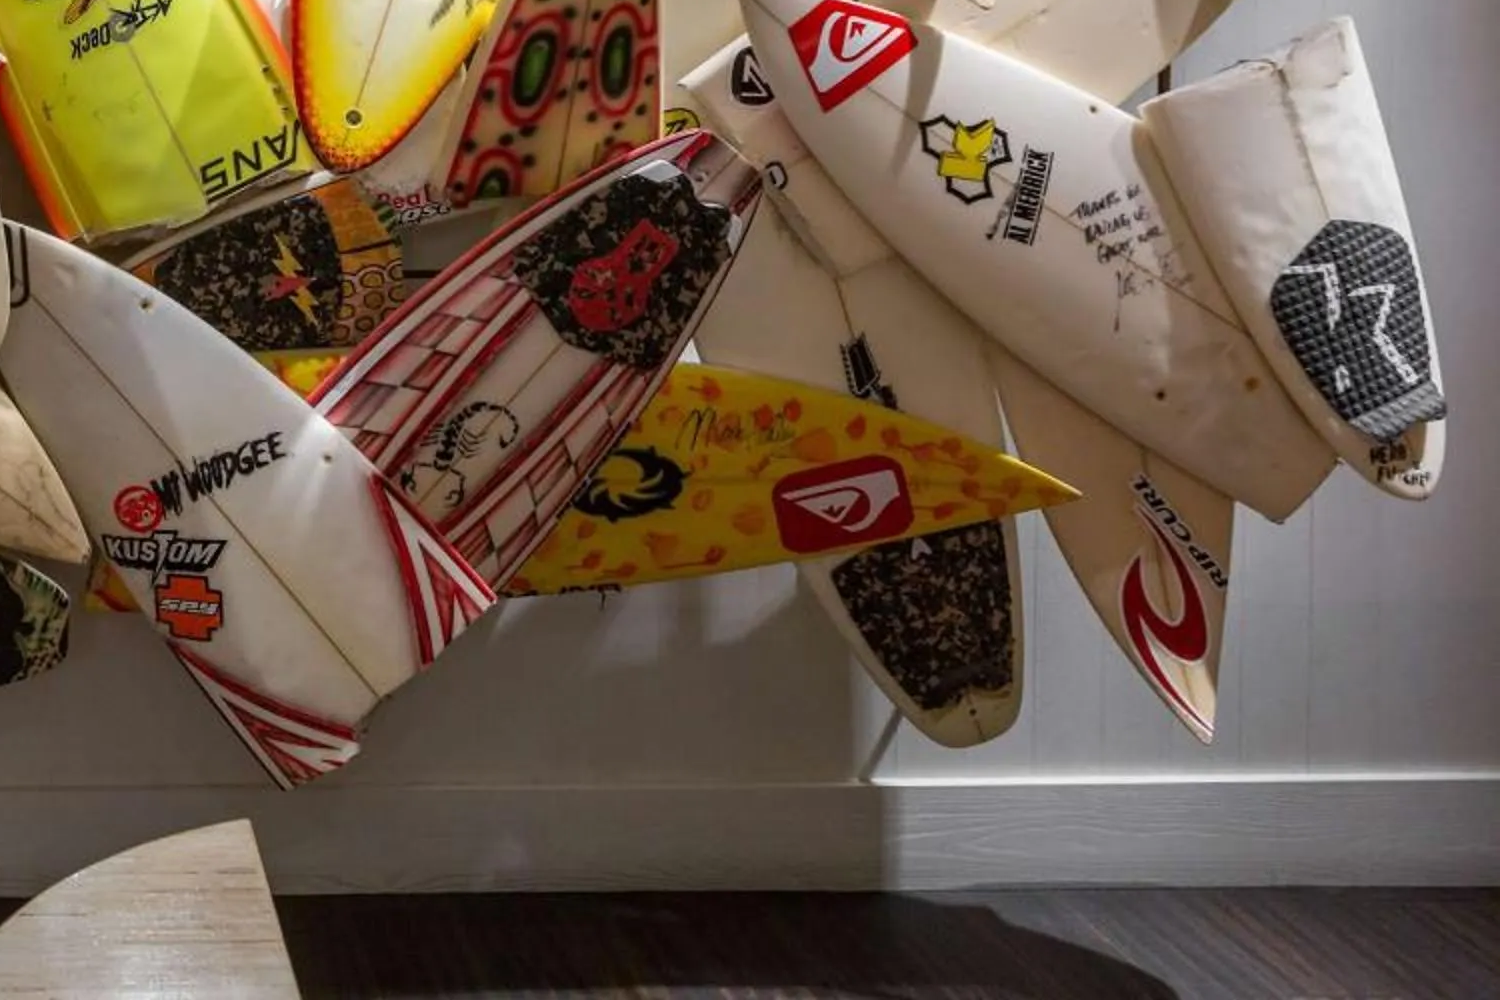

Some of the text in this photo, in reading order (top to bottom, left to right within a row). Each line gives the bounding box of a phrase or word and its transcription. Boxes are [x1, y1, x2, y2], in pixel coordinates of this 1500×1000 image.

[178, 431, 288, 502] WOODGEE
[103, 533, 223, 585] KUSTOM
[1131, 473, 1229, 589] RIP CURL
[159, 598, 220, 617] SPY
